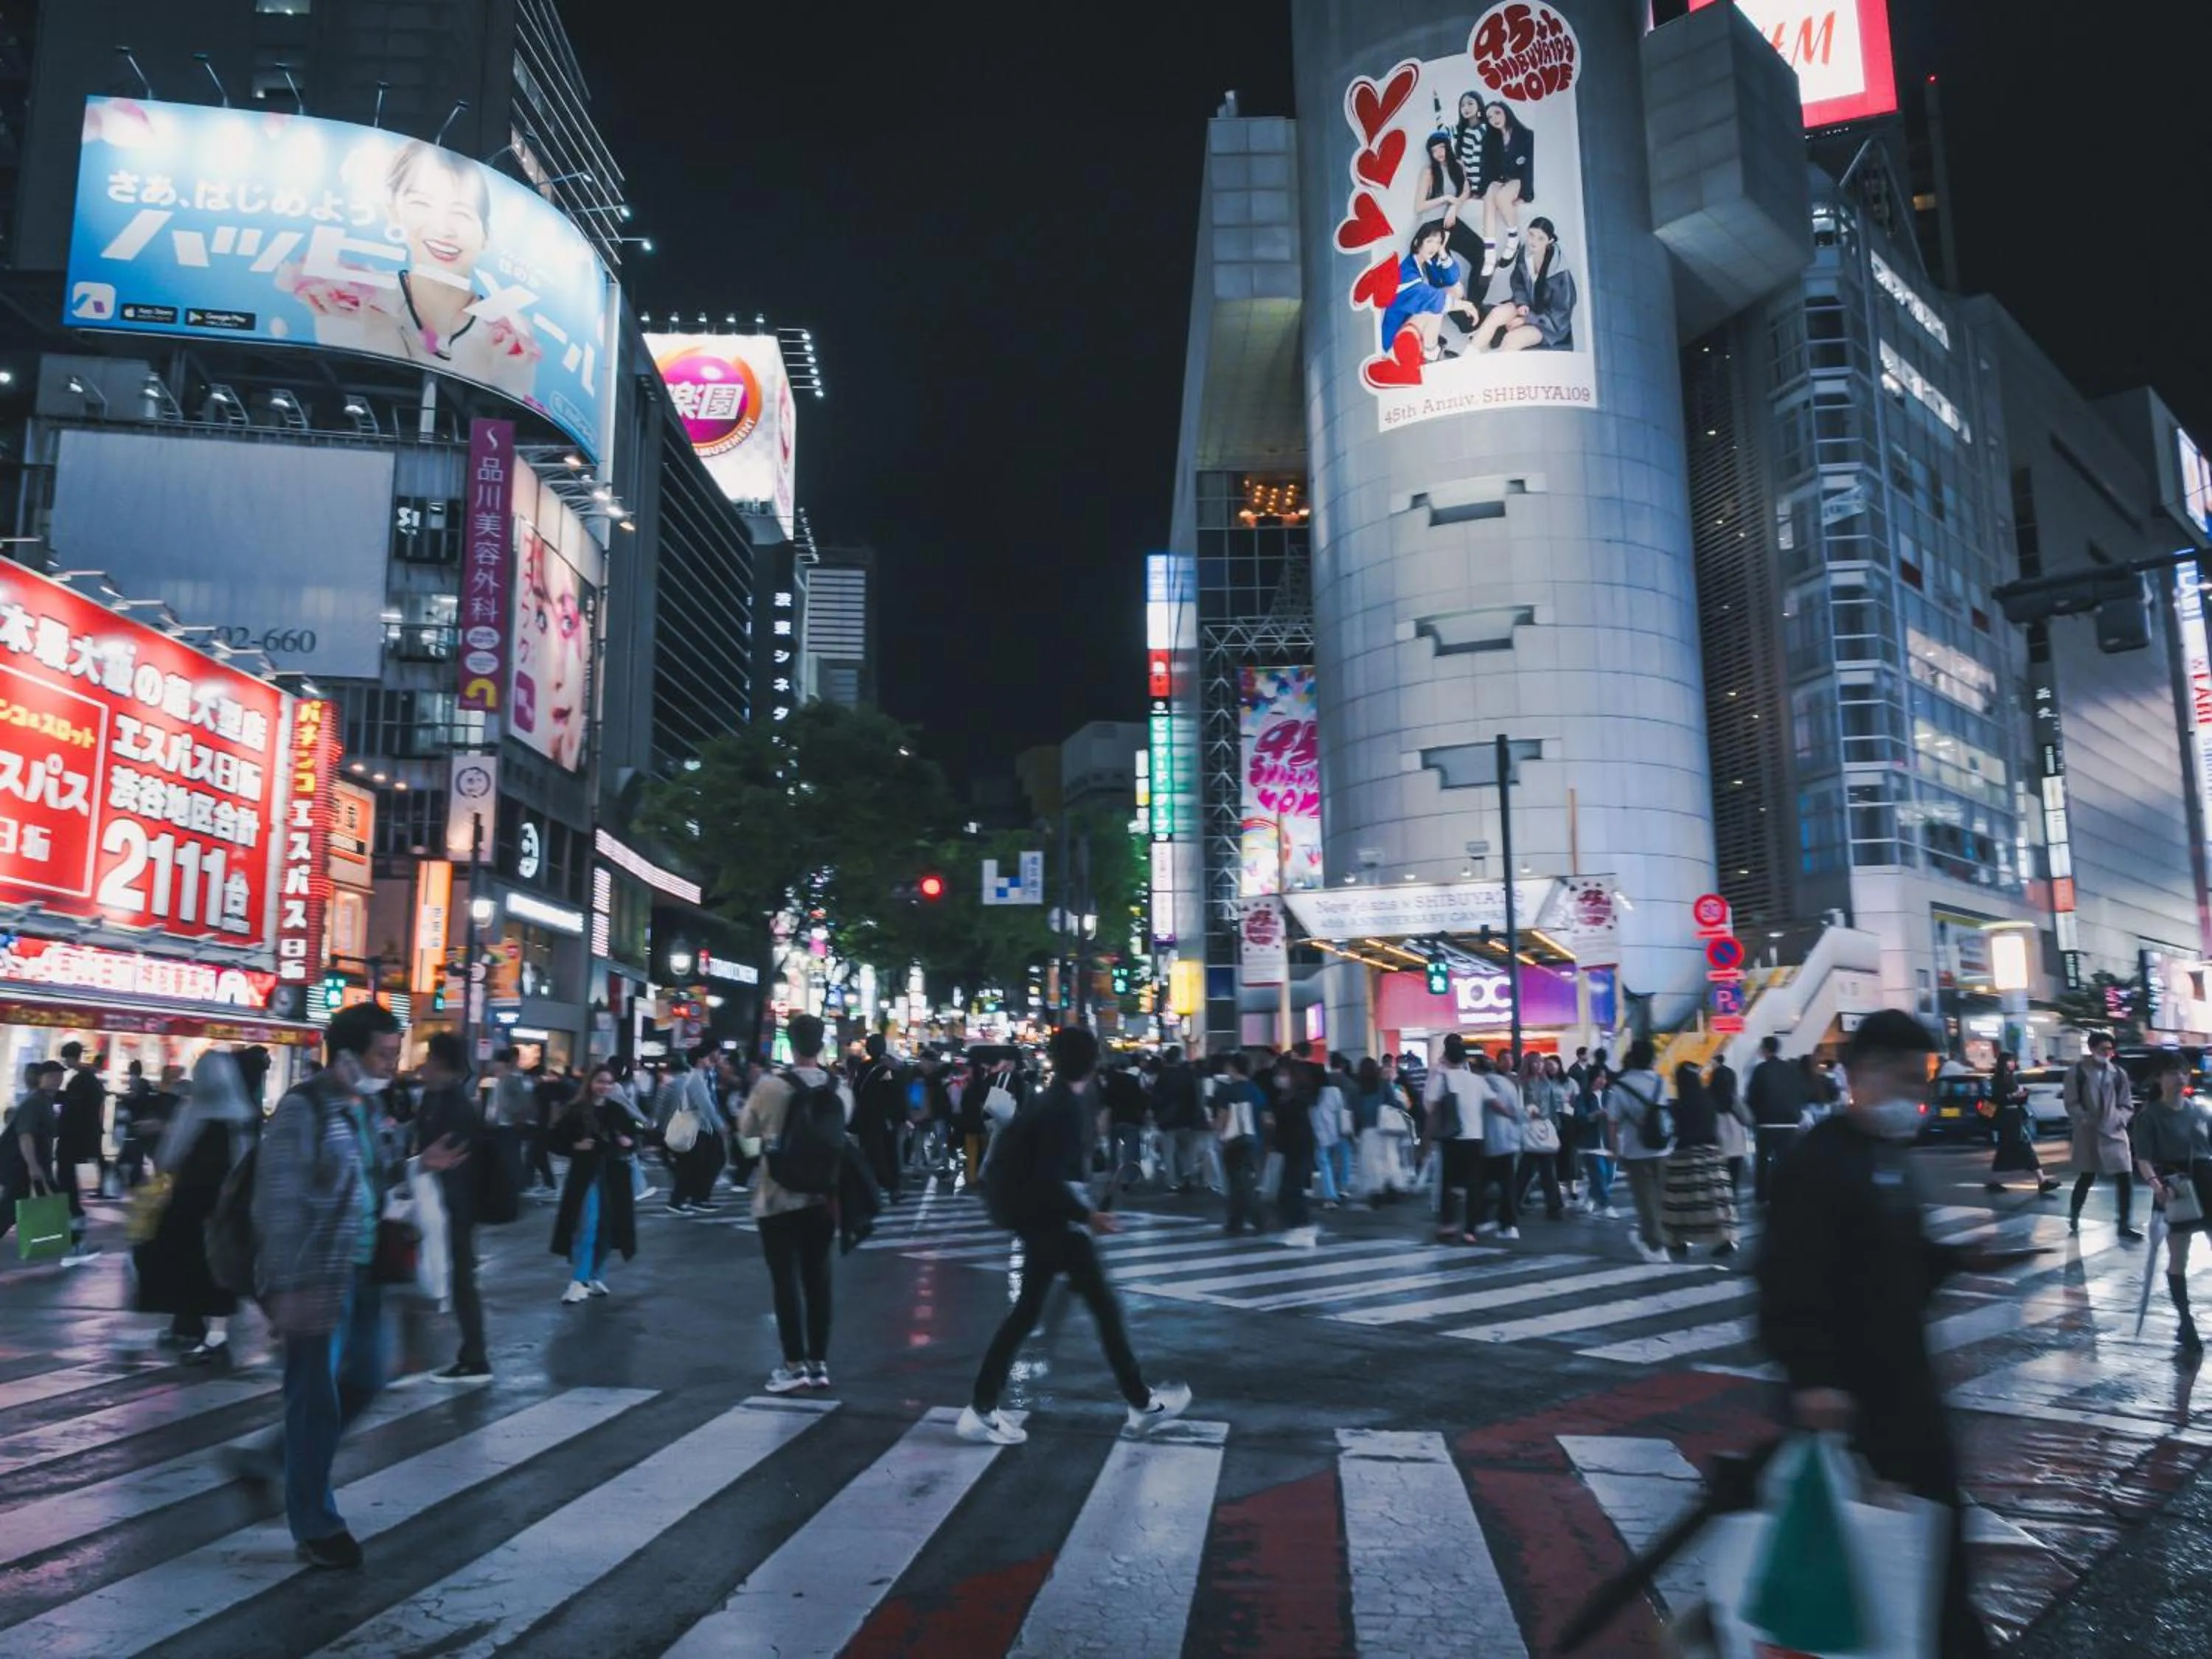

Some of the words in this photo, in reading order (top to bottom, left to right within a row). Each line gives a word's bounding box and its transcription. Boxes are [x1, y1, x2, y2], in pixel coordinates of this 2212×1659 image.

[1477, 35, 1575, 91] SHIBUYA109
[1500, 63, 1573, 102] LOVE
[100, 208, 595, 399] ハッピーメール
[1384, 406, 1417, 425] 45th
[1482, 386, 1591, 403] SHIBUYA109
[470, 456, 504, 623] 品川美容外科
[295, 700, 322, 793] パチンコ
[108, 765, 260, 848] 渋谷地区合計
